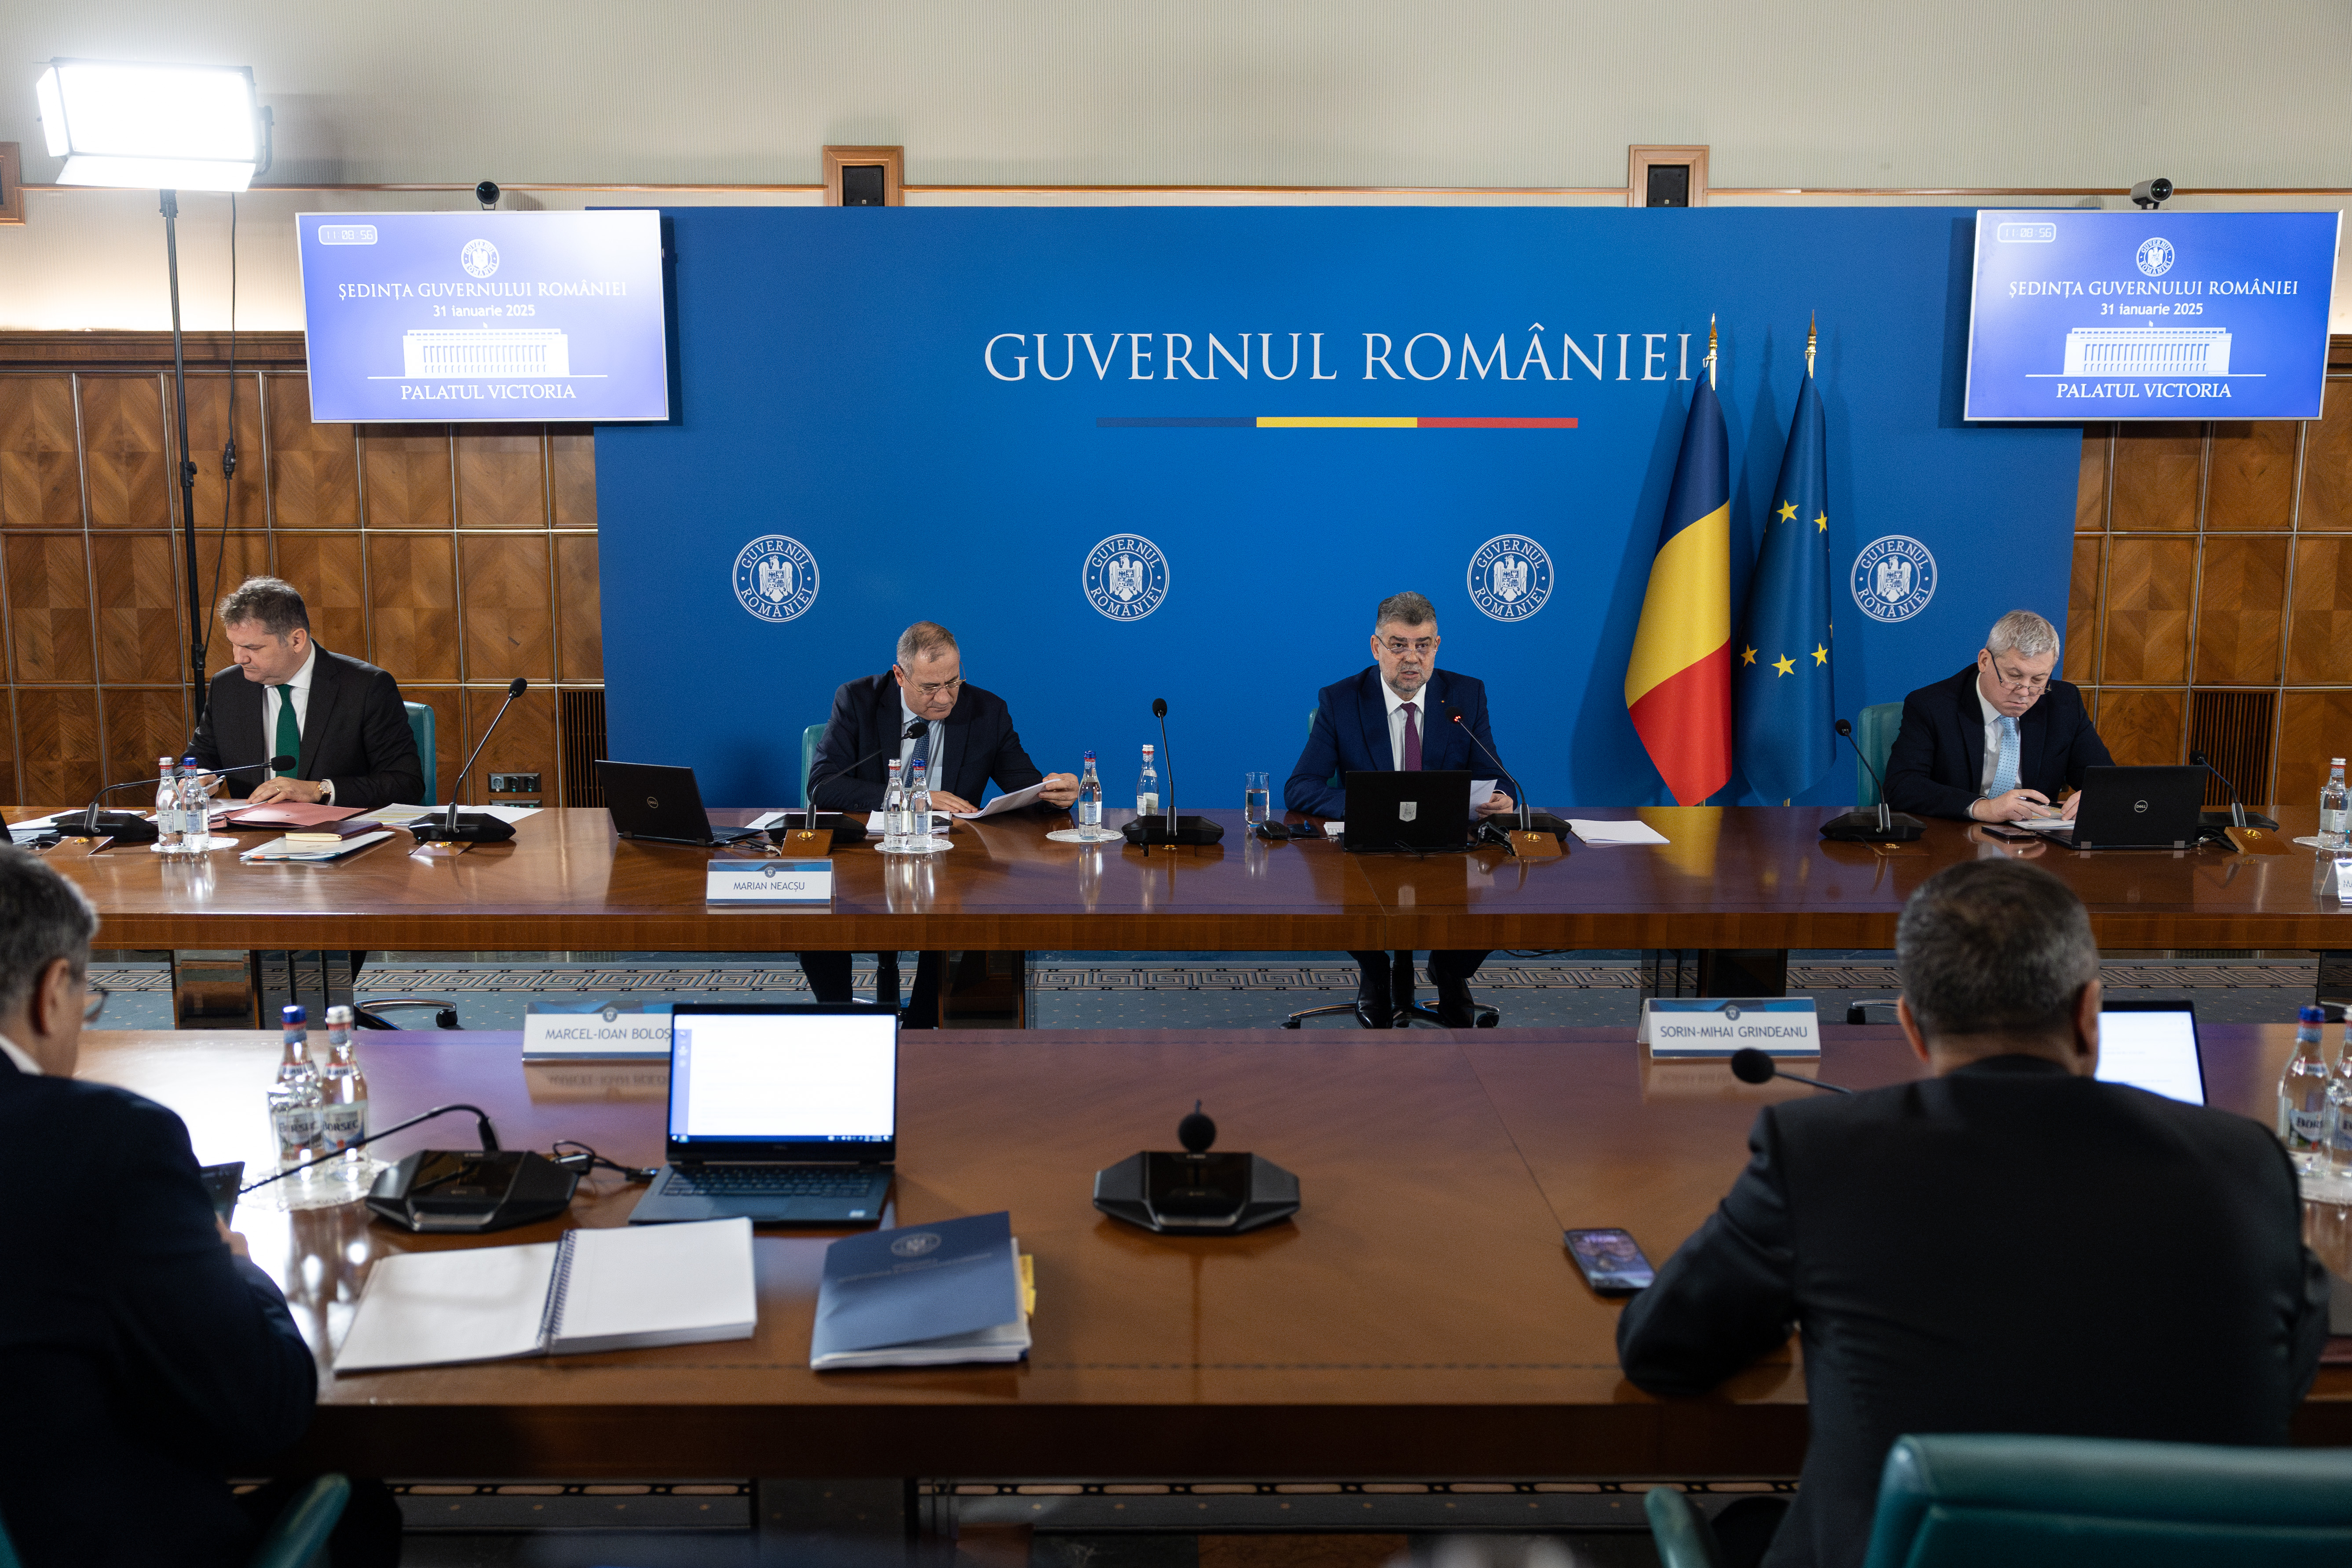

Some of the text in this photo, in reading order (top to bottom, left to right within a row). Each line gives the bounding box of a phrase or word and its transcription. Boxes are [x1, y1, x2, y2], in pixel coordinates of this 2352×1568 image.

[2141, 240, 2171, 253] GUVERNUL
[418, 282, 531, 297] GUVERNULUI
[538, 279, 627, 296] ROMÂNIEI
[2089, 281, 2202, 295] GUVERNULUI
[2209, 278, 2298, 295] ROMÂNIEI
[433, 304, 536, 317] 31 ianuarie 2025
[2100, 303, 2203, 315] 31 ianuarie 2025
[984, 322, 1692, 382] GUVERNUL ROMÂNIEI
[401, 384, 576, 400] PALATUL VICTORIA
[2056, 383, 2232, 398] PALATUL VICTORIA
[741, 540, 810, 570] GUVERNUL
[1092, 539, 1160, 568] GUVERNUL
[1477, 540, 1545, 569] GUVERNUL
[1861, 540, 1929, 570] GUVERNUL
[741, 587, 812, 617] ROMÂNIEI
[1090, 586, 1162, 616] ROMÂNIEI
[1474, 587, 1547, 617] ROMÂNIEI
[1858, 588, 1929, 617] ROMÂNIEI
[733, 882, 805, 892] MARIAN NEACȘU
[545, 1028, 627, 1040] MARCEL-IOAN
[1660, 1026, 1808, 1038] SORIN-MIHAI GRINDEANU
